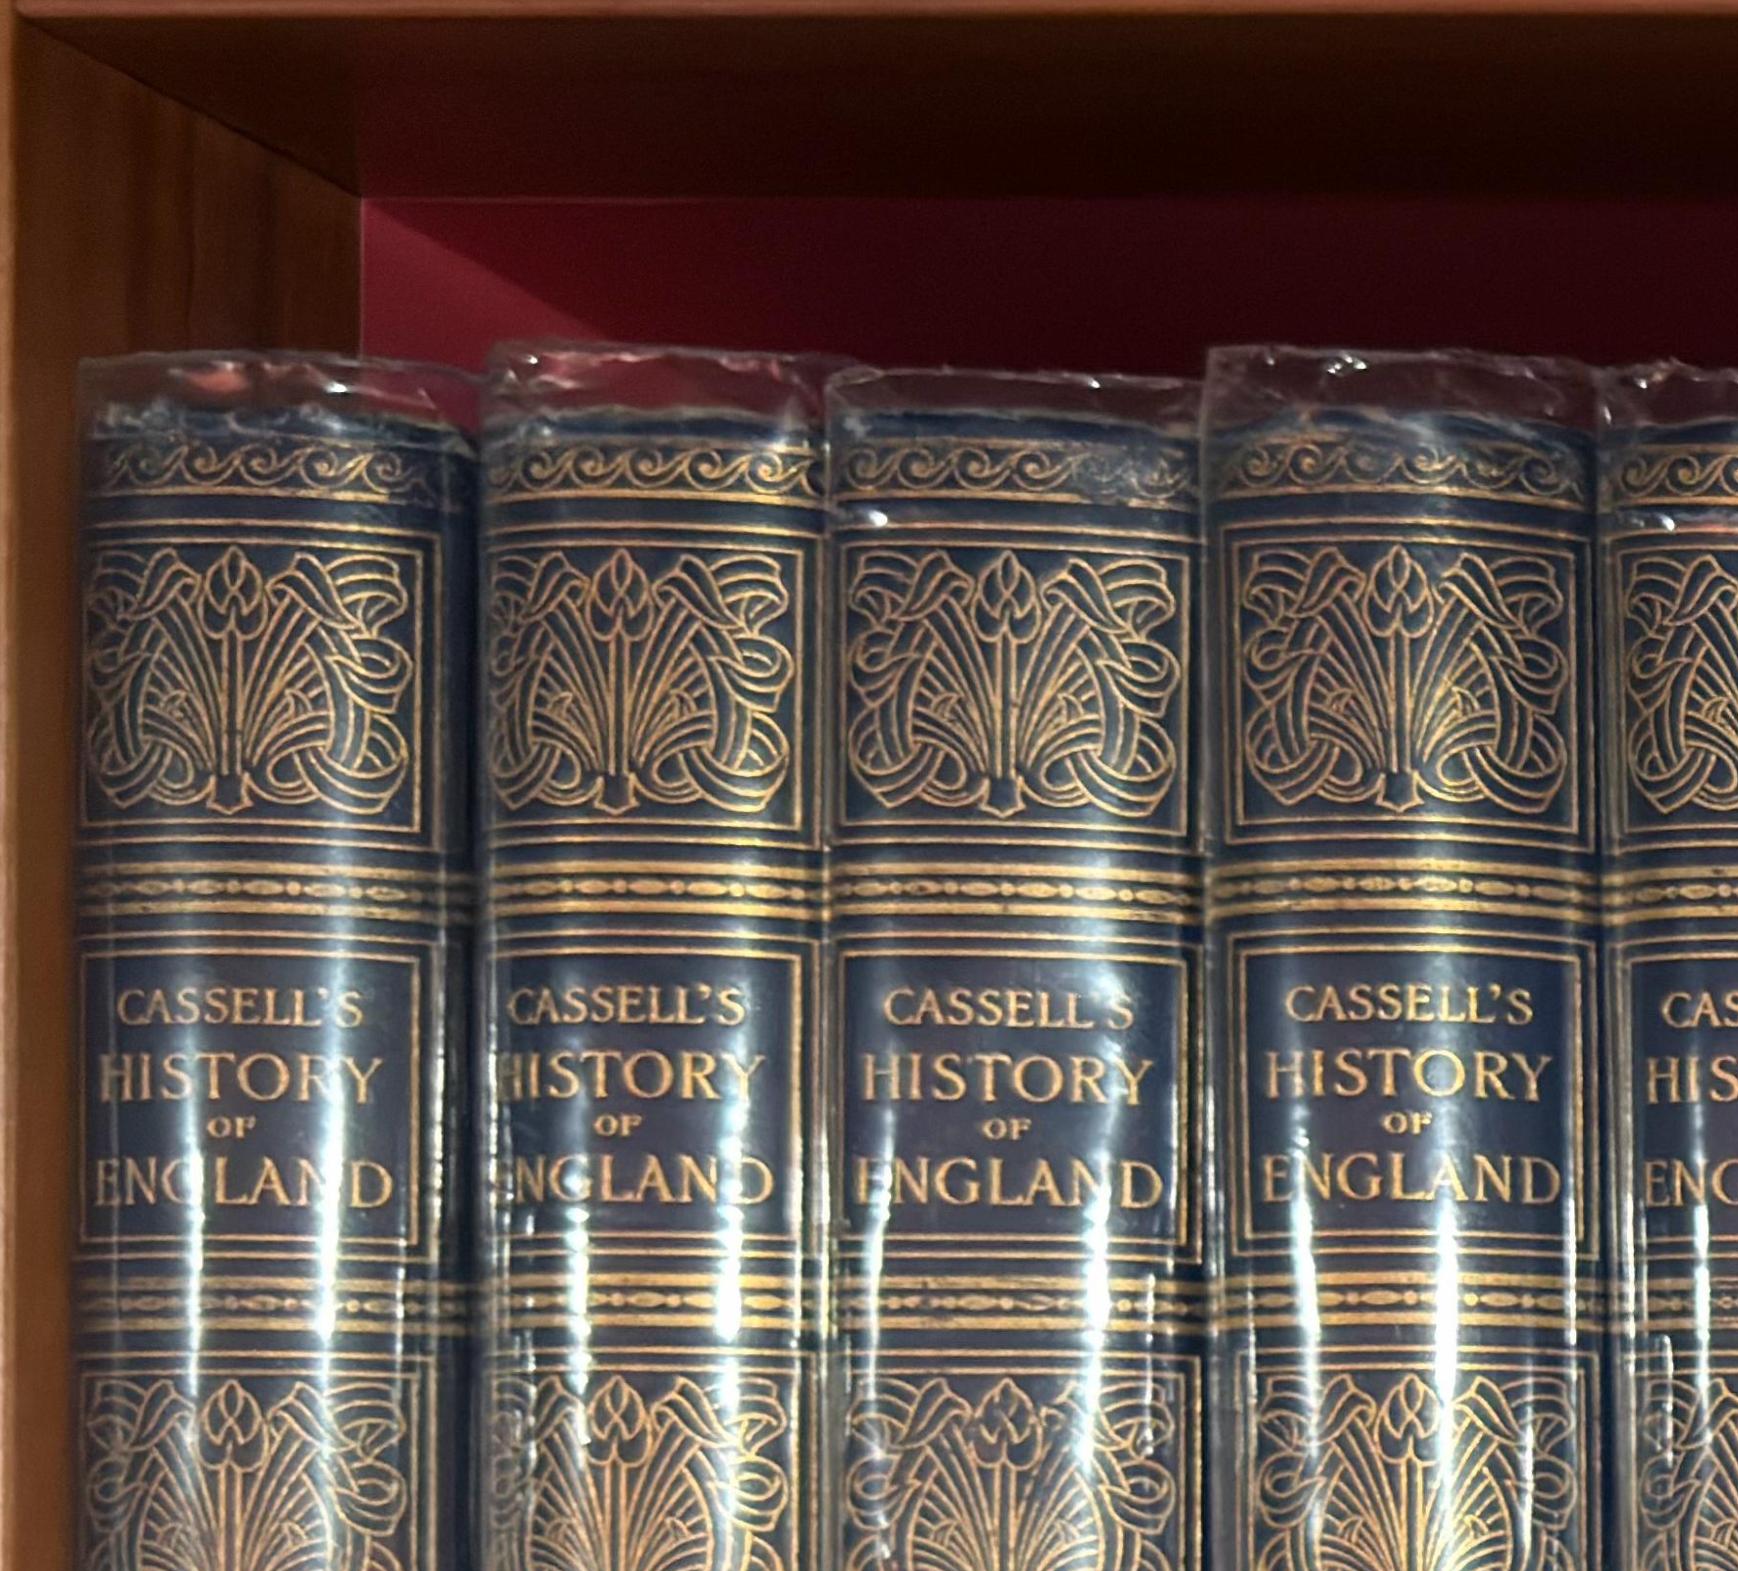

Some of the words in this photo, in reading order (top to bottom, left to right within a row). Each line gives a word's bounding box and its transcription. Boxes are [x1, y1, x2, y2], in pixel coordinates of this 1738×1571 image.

[117, 987, 363, 1028] CASSELL'S
[507, 985, 746, 1026] CASSELL'S
[884, 987, 1134, 1030] CASSELL'S
[1286, 984, 1533, 1026] CASSELL'S
[99, 1053, 384, 1104] HISTORY
[497, 1050, 765, 1101] HISTORY
[862, 1053, 1153, 1105] HISTORY
[1266, 1048, 1551, 1101] HISTORY
[207, 1116, 255, 1138] OF
[594, 1114, 641, 1136] OF
[982, 1119, 1031, 1140] OF
[1381, 1112, 1431, 1134] OF
[495, 1154, 774, 1205] NGLAND
[1262, 1153, 1561, 1205] ENGLAND
